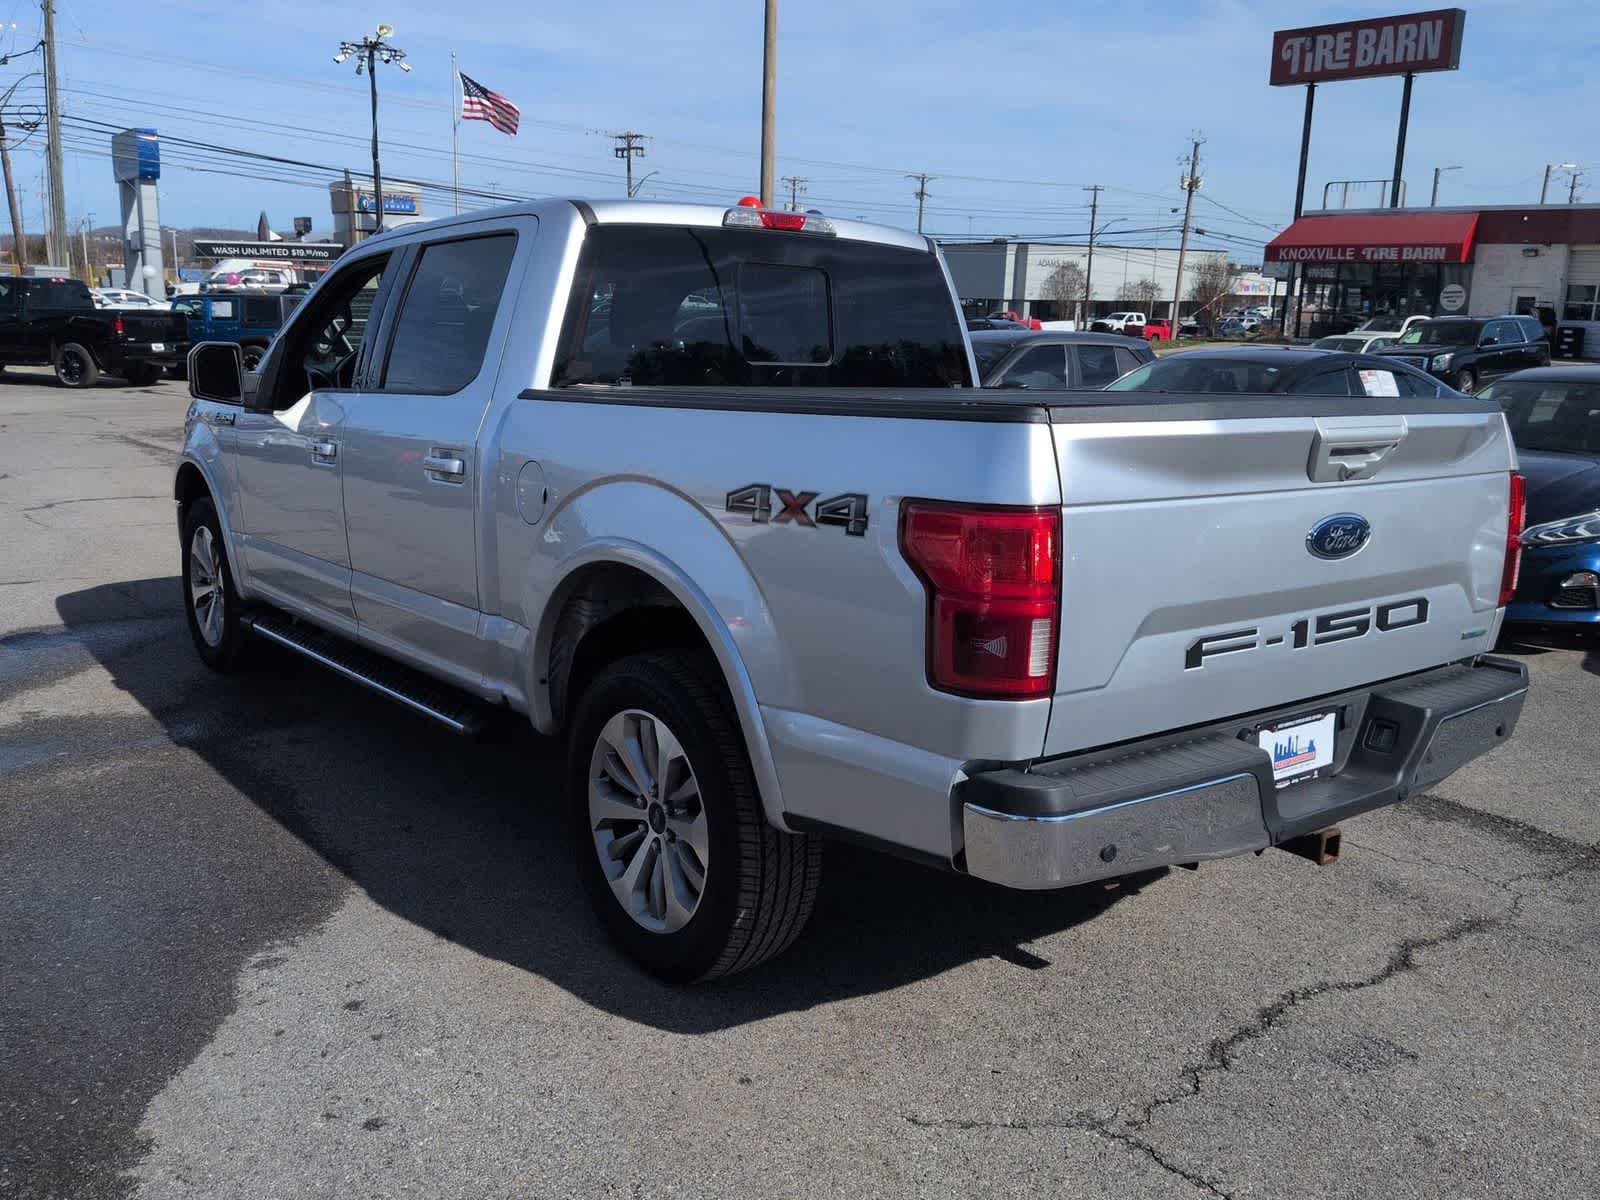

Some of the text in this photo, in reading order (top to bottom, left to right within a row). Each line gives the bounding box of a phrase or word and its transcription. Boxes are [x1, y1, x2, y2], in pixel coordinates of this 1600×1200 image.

[1355, 20, 1443, 68] BARN
[212, 246, 240, 255] WASH
[241, 247, 289, 257] UNLIMITED
[1279, 247, 1355, 261] KNOXVILLE
[1402, 247, 1446, 260] BARN
[1321, 523, 1362, 552] Ford
[1184, 597, 1430, 671] F-150
